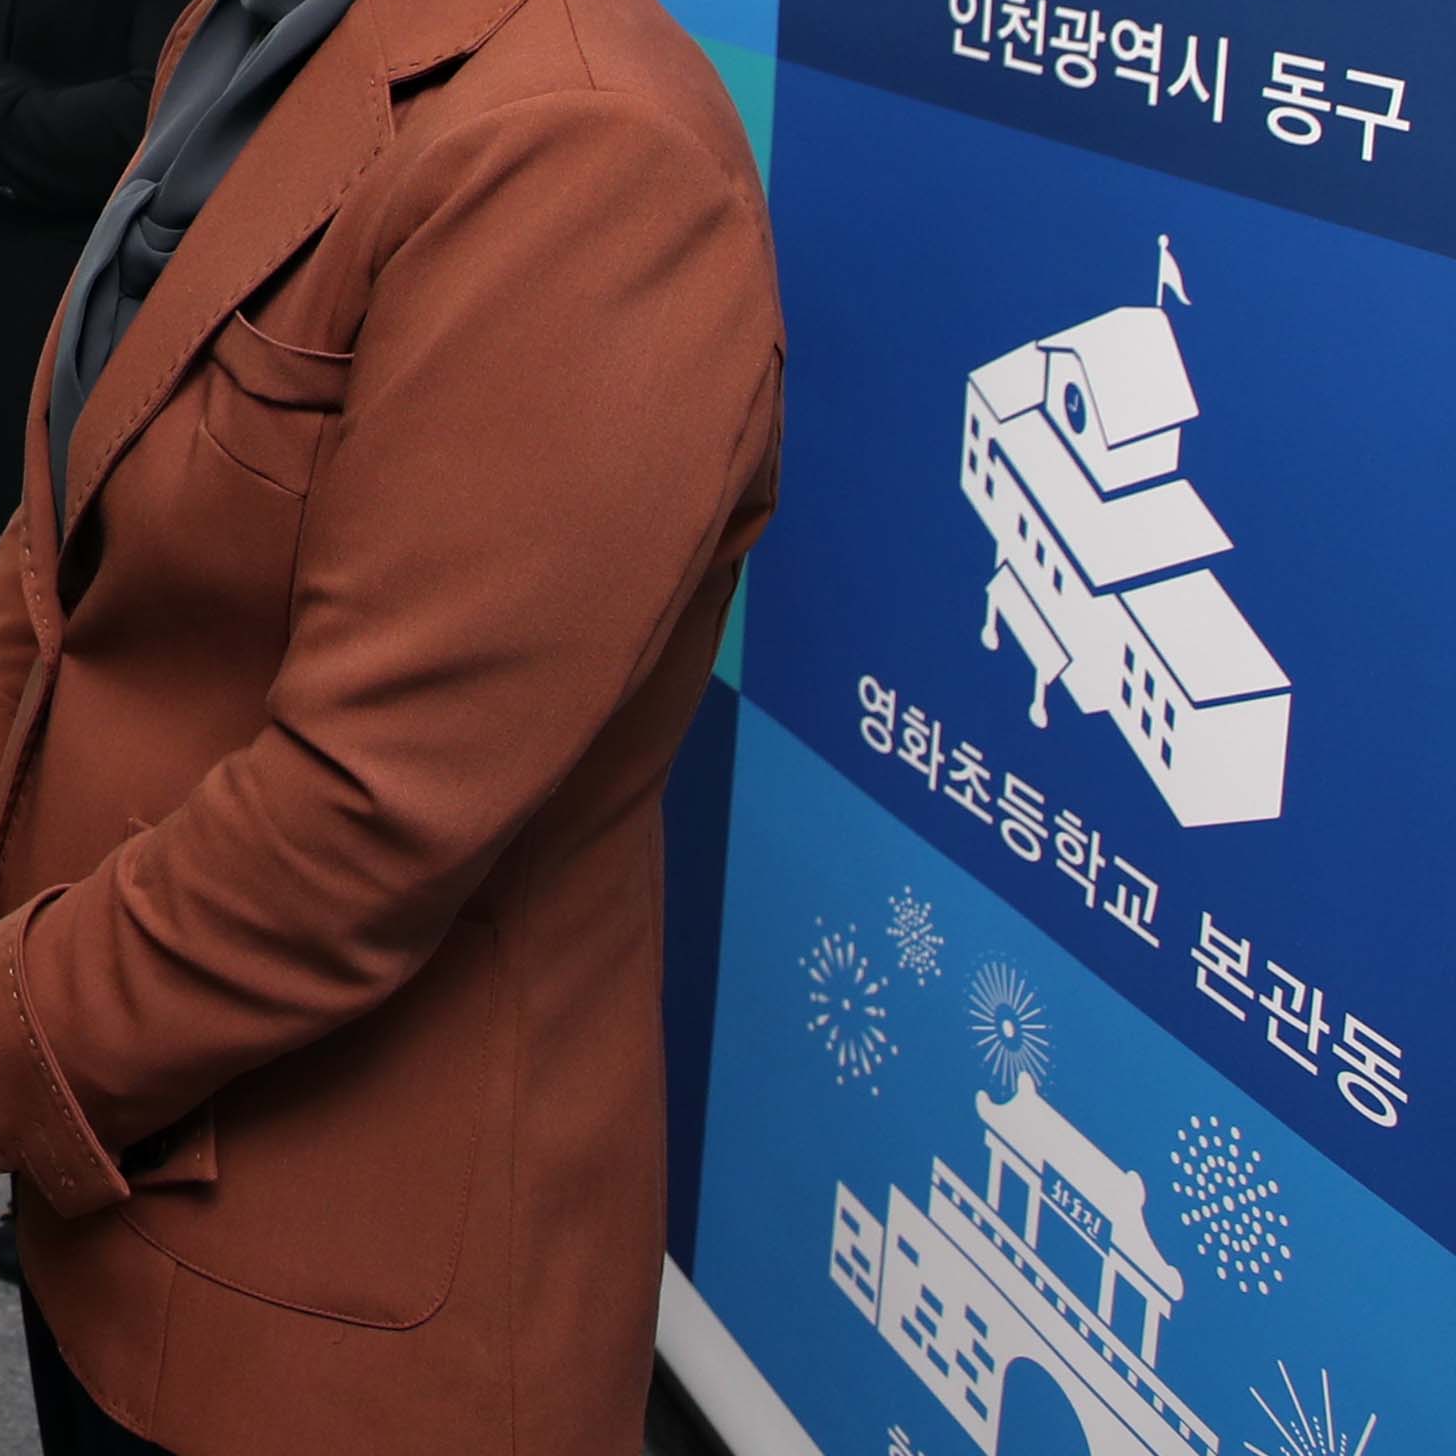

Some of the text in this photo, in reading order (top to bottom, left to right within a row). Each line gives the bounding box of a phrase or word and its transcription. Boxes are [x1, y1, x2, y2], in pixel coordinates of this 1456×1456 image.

[1261, 51, 1411, 163] 동구
[858, 675, 1408, 1128] 영화초등학교 본관동
